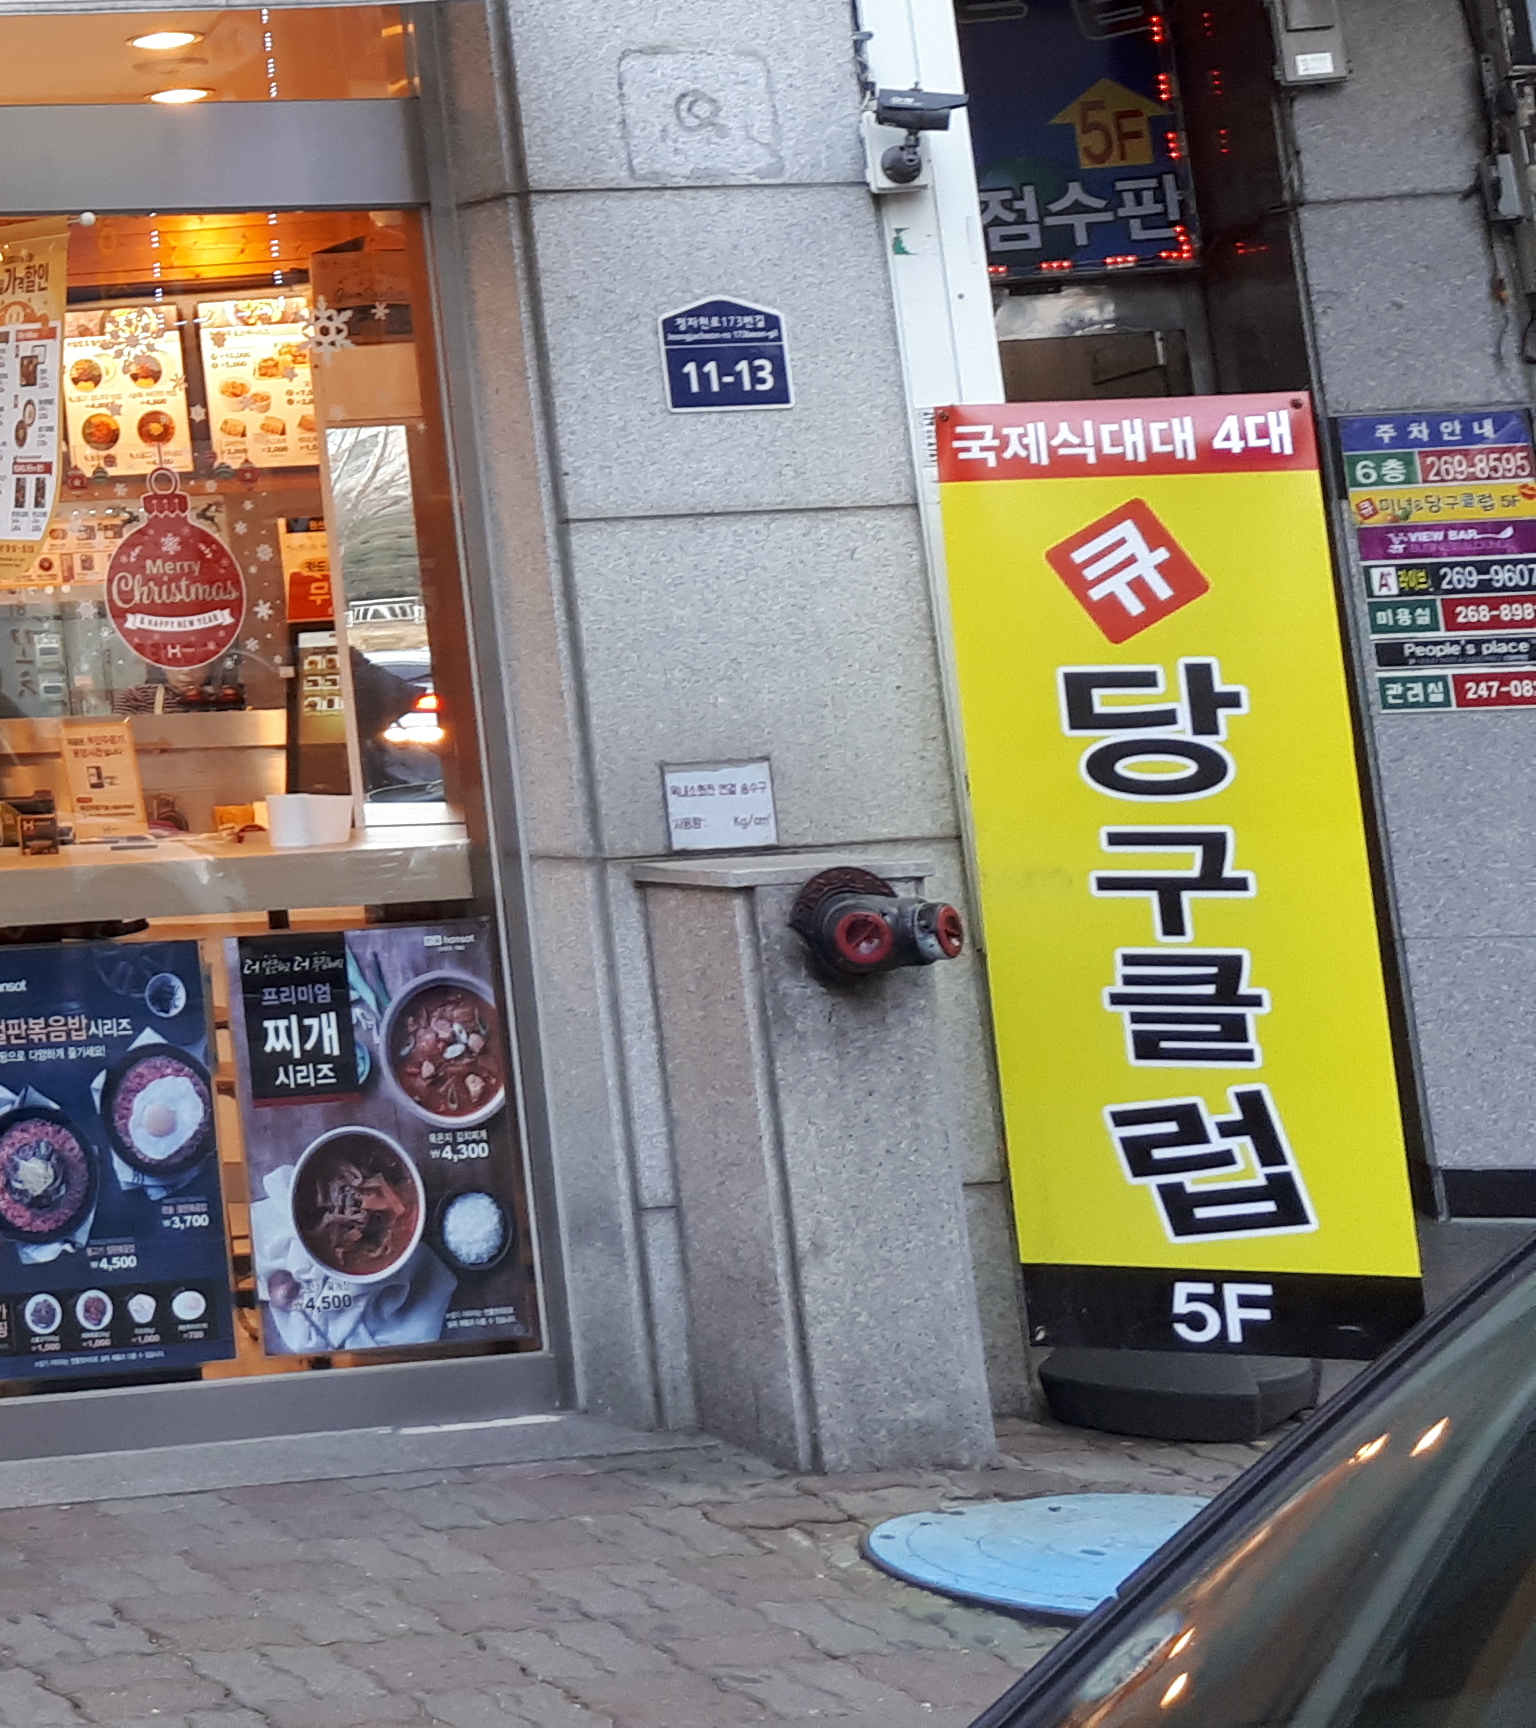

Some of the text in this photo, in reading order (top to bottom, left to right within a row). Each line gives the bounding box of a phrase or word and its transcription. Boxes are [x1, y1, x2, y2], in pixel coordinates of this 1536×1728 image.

[1079, 100, 1150, 166] 5F
[977, 173, 1185, 252] 점수판
[681, 358, 775, 394] 11-13
[951, 408, 1295, 469] 국제식대대 4대
[1355, 452, 1531, 485] 6층 269-8595
[145, 559, 201, 577] Merry
[112, 572, 240, 608] Christmas
[1375, 602, 1536, 627] 미용실 268-898
[1402, 639, 1531, 658] People's place
[1384, 680, 1445, 705] 관리실
[1055, 654, 1319, 1245] 당구클럽
[261, 982, 332, 1007] 프리미엄
[262, 1011, 341, 1060] 찌개
[275, 1063, 338, 1089] 시리즈
[1171, 1282, 1274, 1344] 5F
